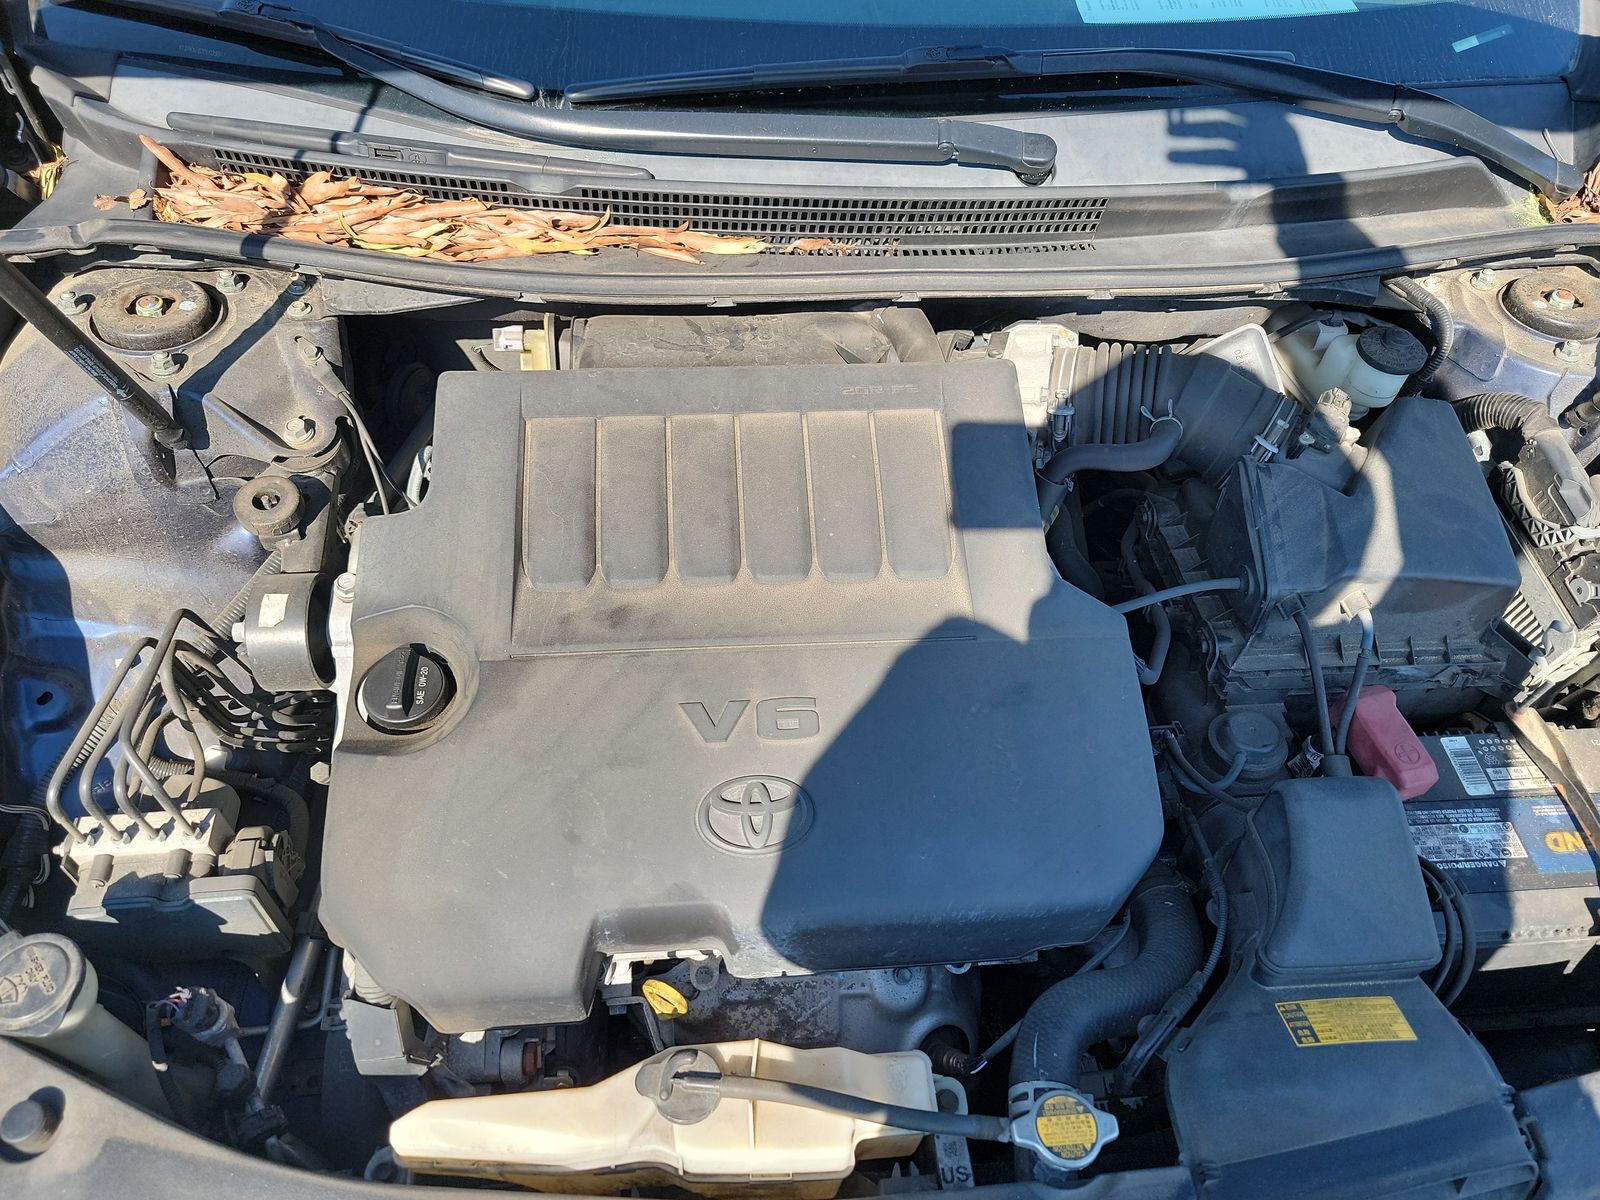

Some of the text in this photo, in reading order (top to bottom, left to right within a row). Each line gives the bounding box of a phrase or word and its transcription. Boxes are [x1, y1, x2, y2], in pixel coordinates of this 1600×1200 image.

[416, 666, 429, 705] SAE 0W-20
[679, 696, 821, 743] V6
[941, 1166, 971, 1184] US
